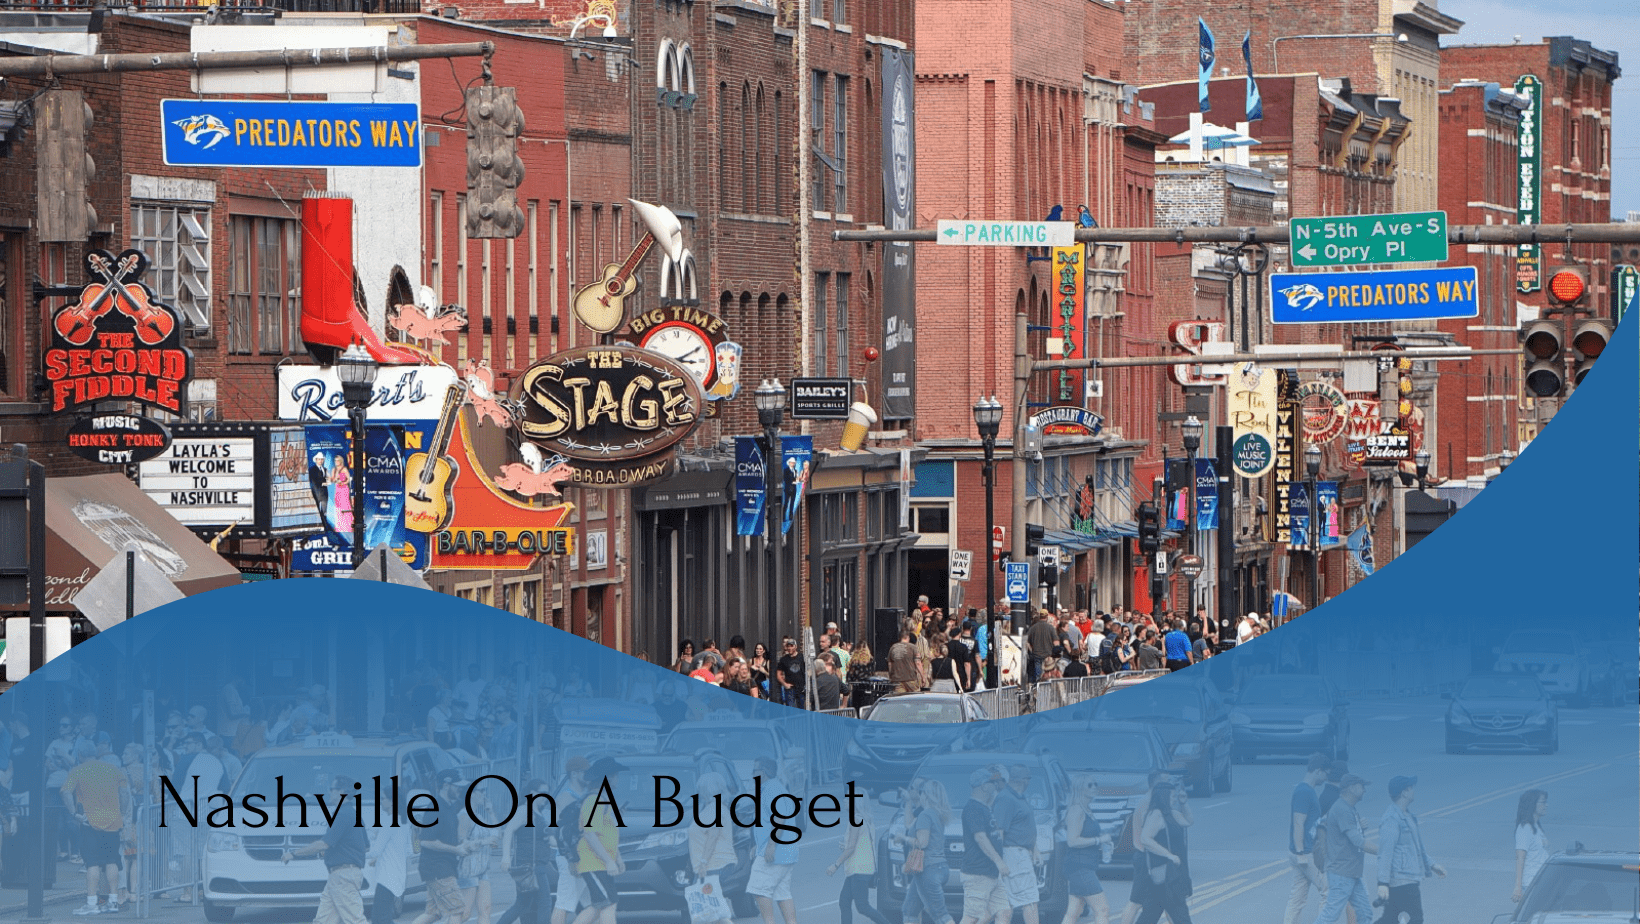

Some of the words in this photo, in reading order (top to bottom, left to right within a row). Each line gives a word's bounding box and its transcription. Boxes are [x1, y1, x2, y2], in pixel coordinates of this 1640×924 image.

[234, 118, 361, 147] PREDATORS
[370, 119, 418, 148] WAY
[1520, 163, 1533, 210] EYED
[964, 224, 1047, 243] PARKING
[1296, 222, 1358, 239] N-5th
[1371, 217, 1440, 237] Ave-S
[1324, 245, 1370, 262] Opry
[1386, 241, 1405, 257] Pl
[1328, 283, 1429, 308] PREDATORS
[1436, 280, 1475, 303] WAY
[629, 308, 666, 335] BIG
[671, 306, 723, 335] TIME
[97, 332, 135, 348] THE
[46, 349, 186, 380] SECOND
[587, 351, 623, 369] THE
[53, 375, 180, 412] FIDDLE
[291, 370, 429, 421] Rort's
[796, 386, 847, 397] BAILEY'S
[521, 364, 695, 438] STAGE
[1236, 390, 1266, 410] Tin
[92, 415, 140, 430] MUSIC
[1036, 408, 1080, 427] RESTAURANT
[1083, 412, 1099, 428] BAR
[1231, 411, 1271, 433] Roof
[69, 434, 118, 447] HONKY
[123, 434, 163, 447] TONK
[1243, 442, 1261, 451] LIVE
[1366, 435, 1408, 446] BENT
[98, 450, 134, 463] CITY
[173, 444, 231, 458] LAYLA'S
[1238, 451, 1266, 460] MUSIC
[1366, 446, 1408, 458] Saloon
[169, 459, 235, 474] WELCOME
[367, 457, 399, 468] CMA
[737, 463, 761, 473] CMA
[1240, 460, 1265, 469] JOINT
[573, 461, 667, 483] BROADWAY
[1277, 411, 1292, 542] VALENTINE
[192, 476, 208, 489] TO
[170, 491, 238, 505] NASHVILLE
[437, 530, 568, 555] BAR-B-QUE
[954, 552, 969, 560] ONE
[1041, 548, 1057, 556] ONE
[952, 560, 969, 568] WAY
[1010, 564, 1026, 573] TAXI
[1007, 572, 1028, 580] STAND
[316, 738, 340, 747] TAXI
